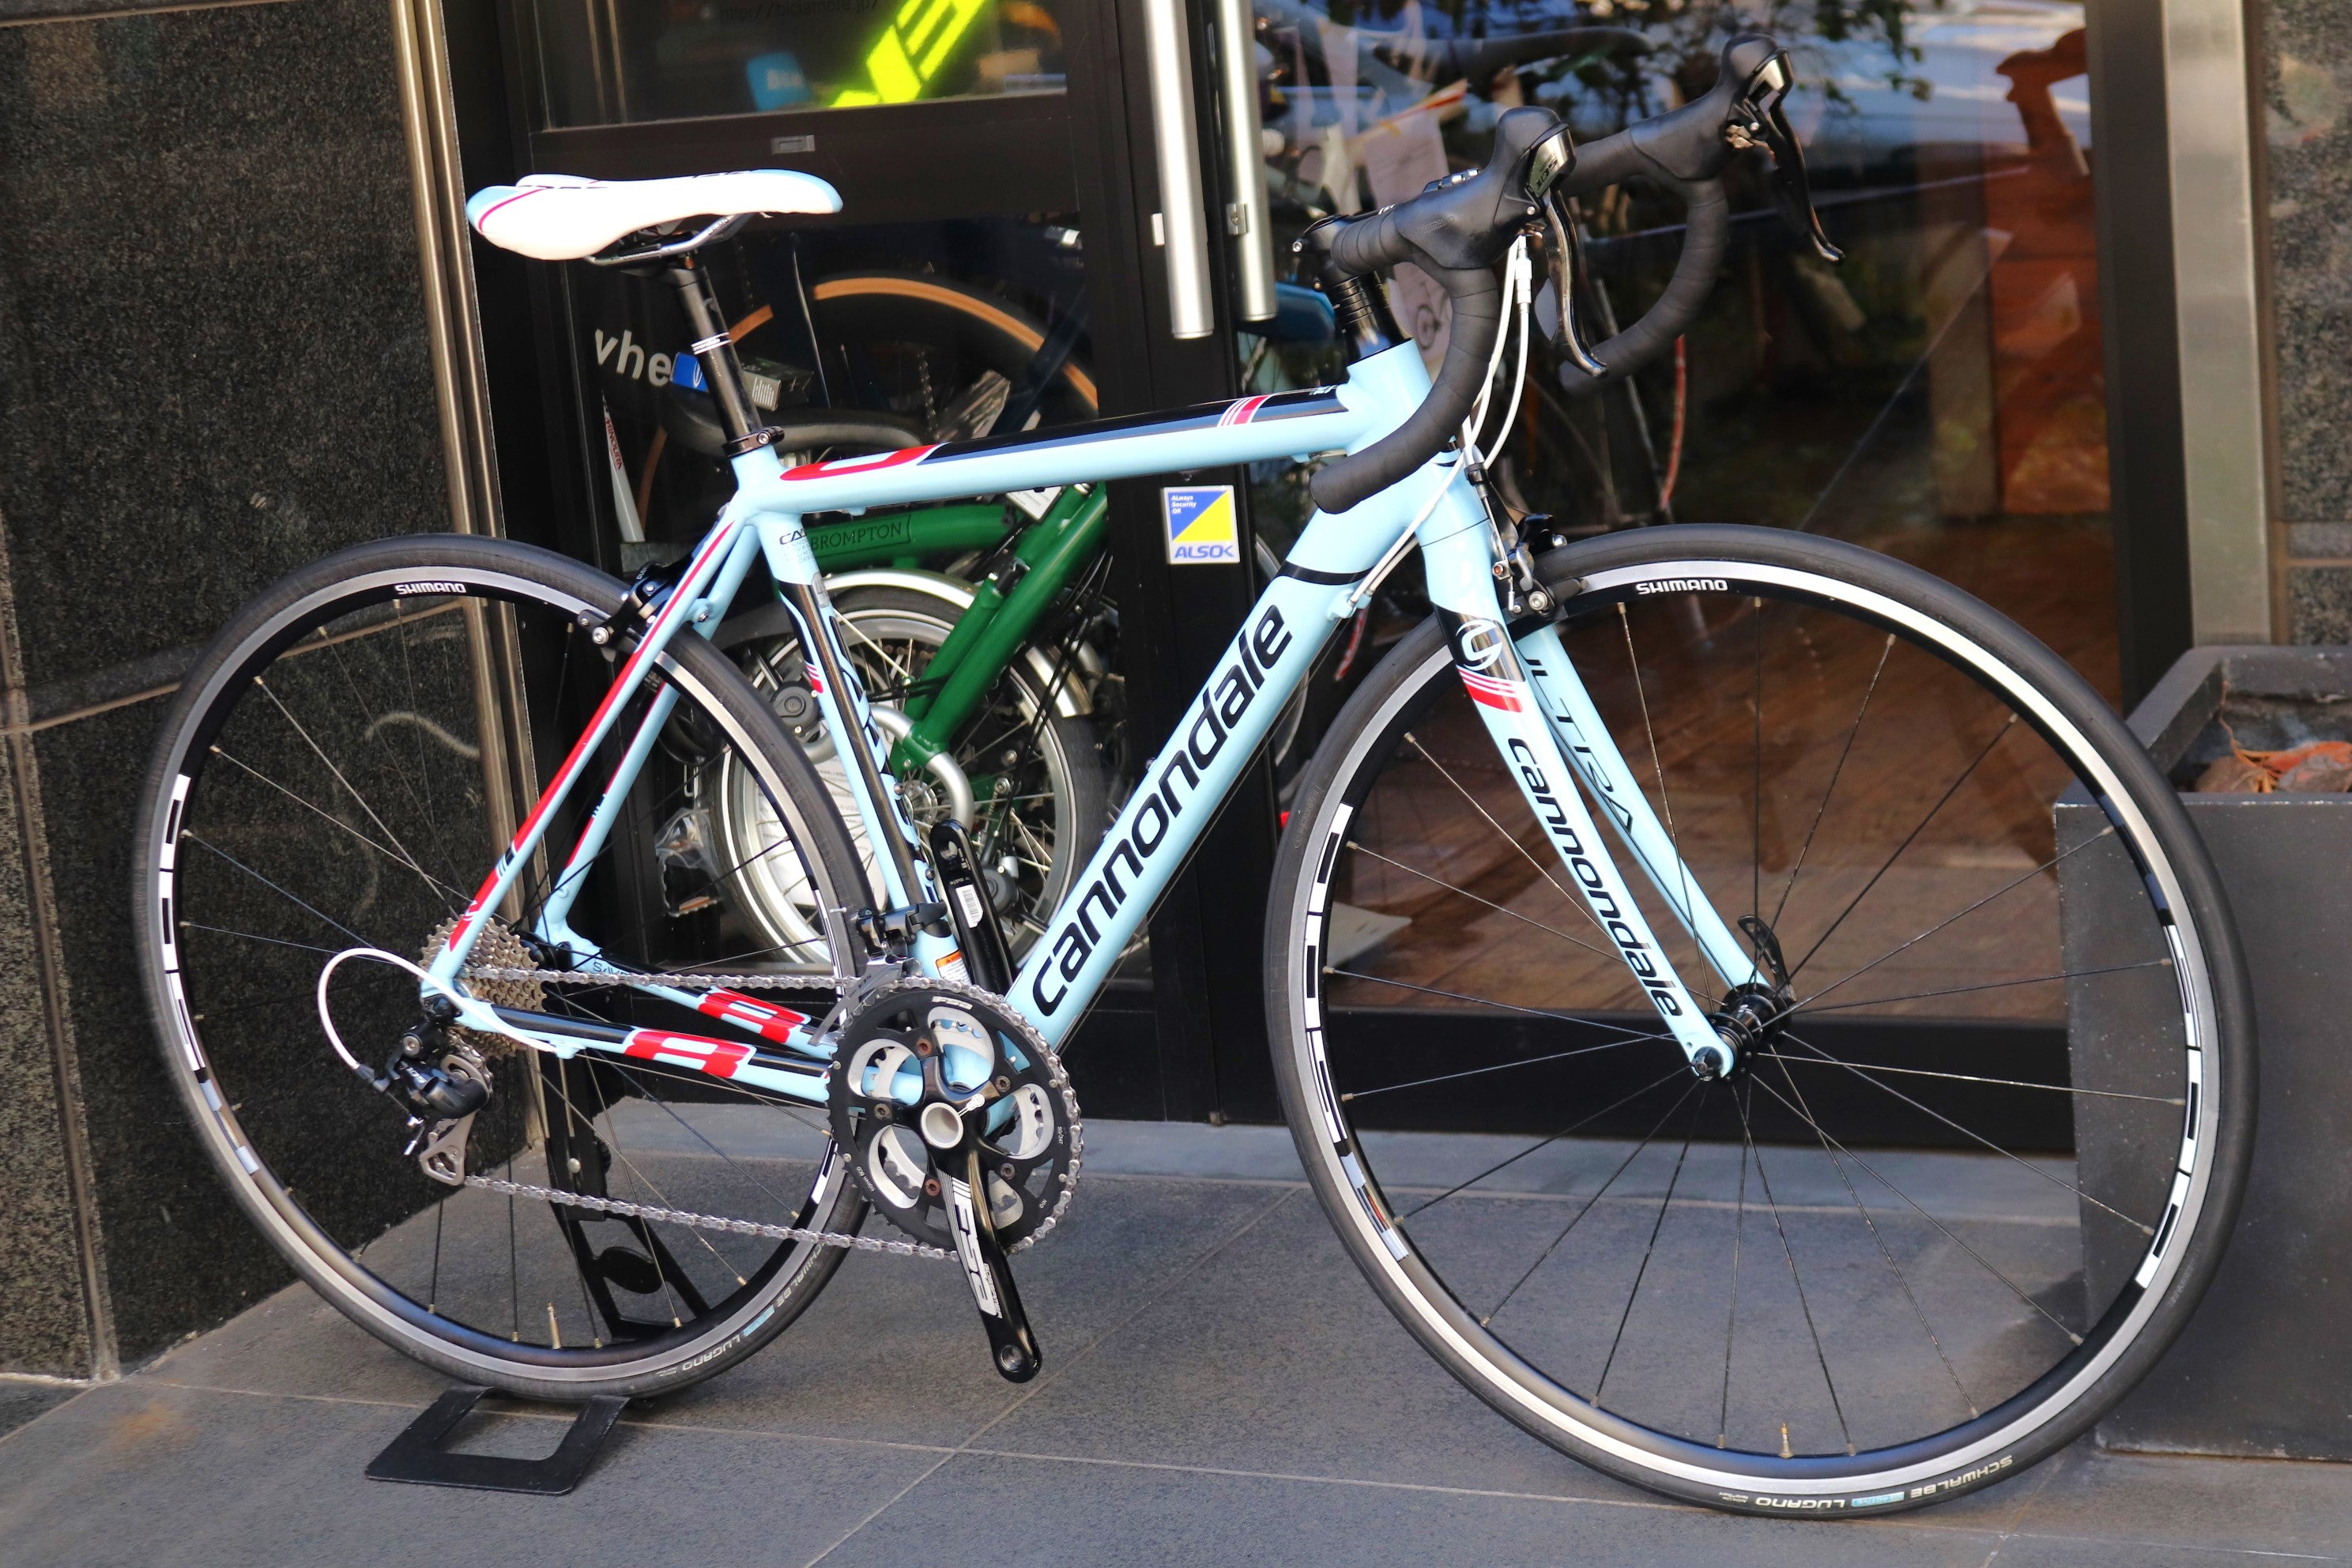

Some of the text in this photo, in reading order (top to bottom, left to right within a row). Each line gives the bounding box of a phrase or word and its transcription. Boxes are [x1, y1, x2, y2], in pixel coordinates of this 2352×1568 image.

[811, 522, 903, 551] BROMPTON
[1174, 545, 1234, 558] ALSOK
[394, 582, 467, 595] SHIMANO
[1635, 579, 1728, 595] SHIMANO
[1032, 604, 1293, 1017] cannondale
[1508, 737, 1683, 1016] cannondale
[683, 1334, 741, 1371] LUGANO
[1909, 1454, 2014, 1498] SCHWALBE
[1755, 1496, 1846, 1509] LUGANO
